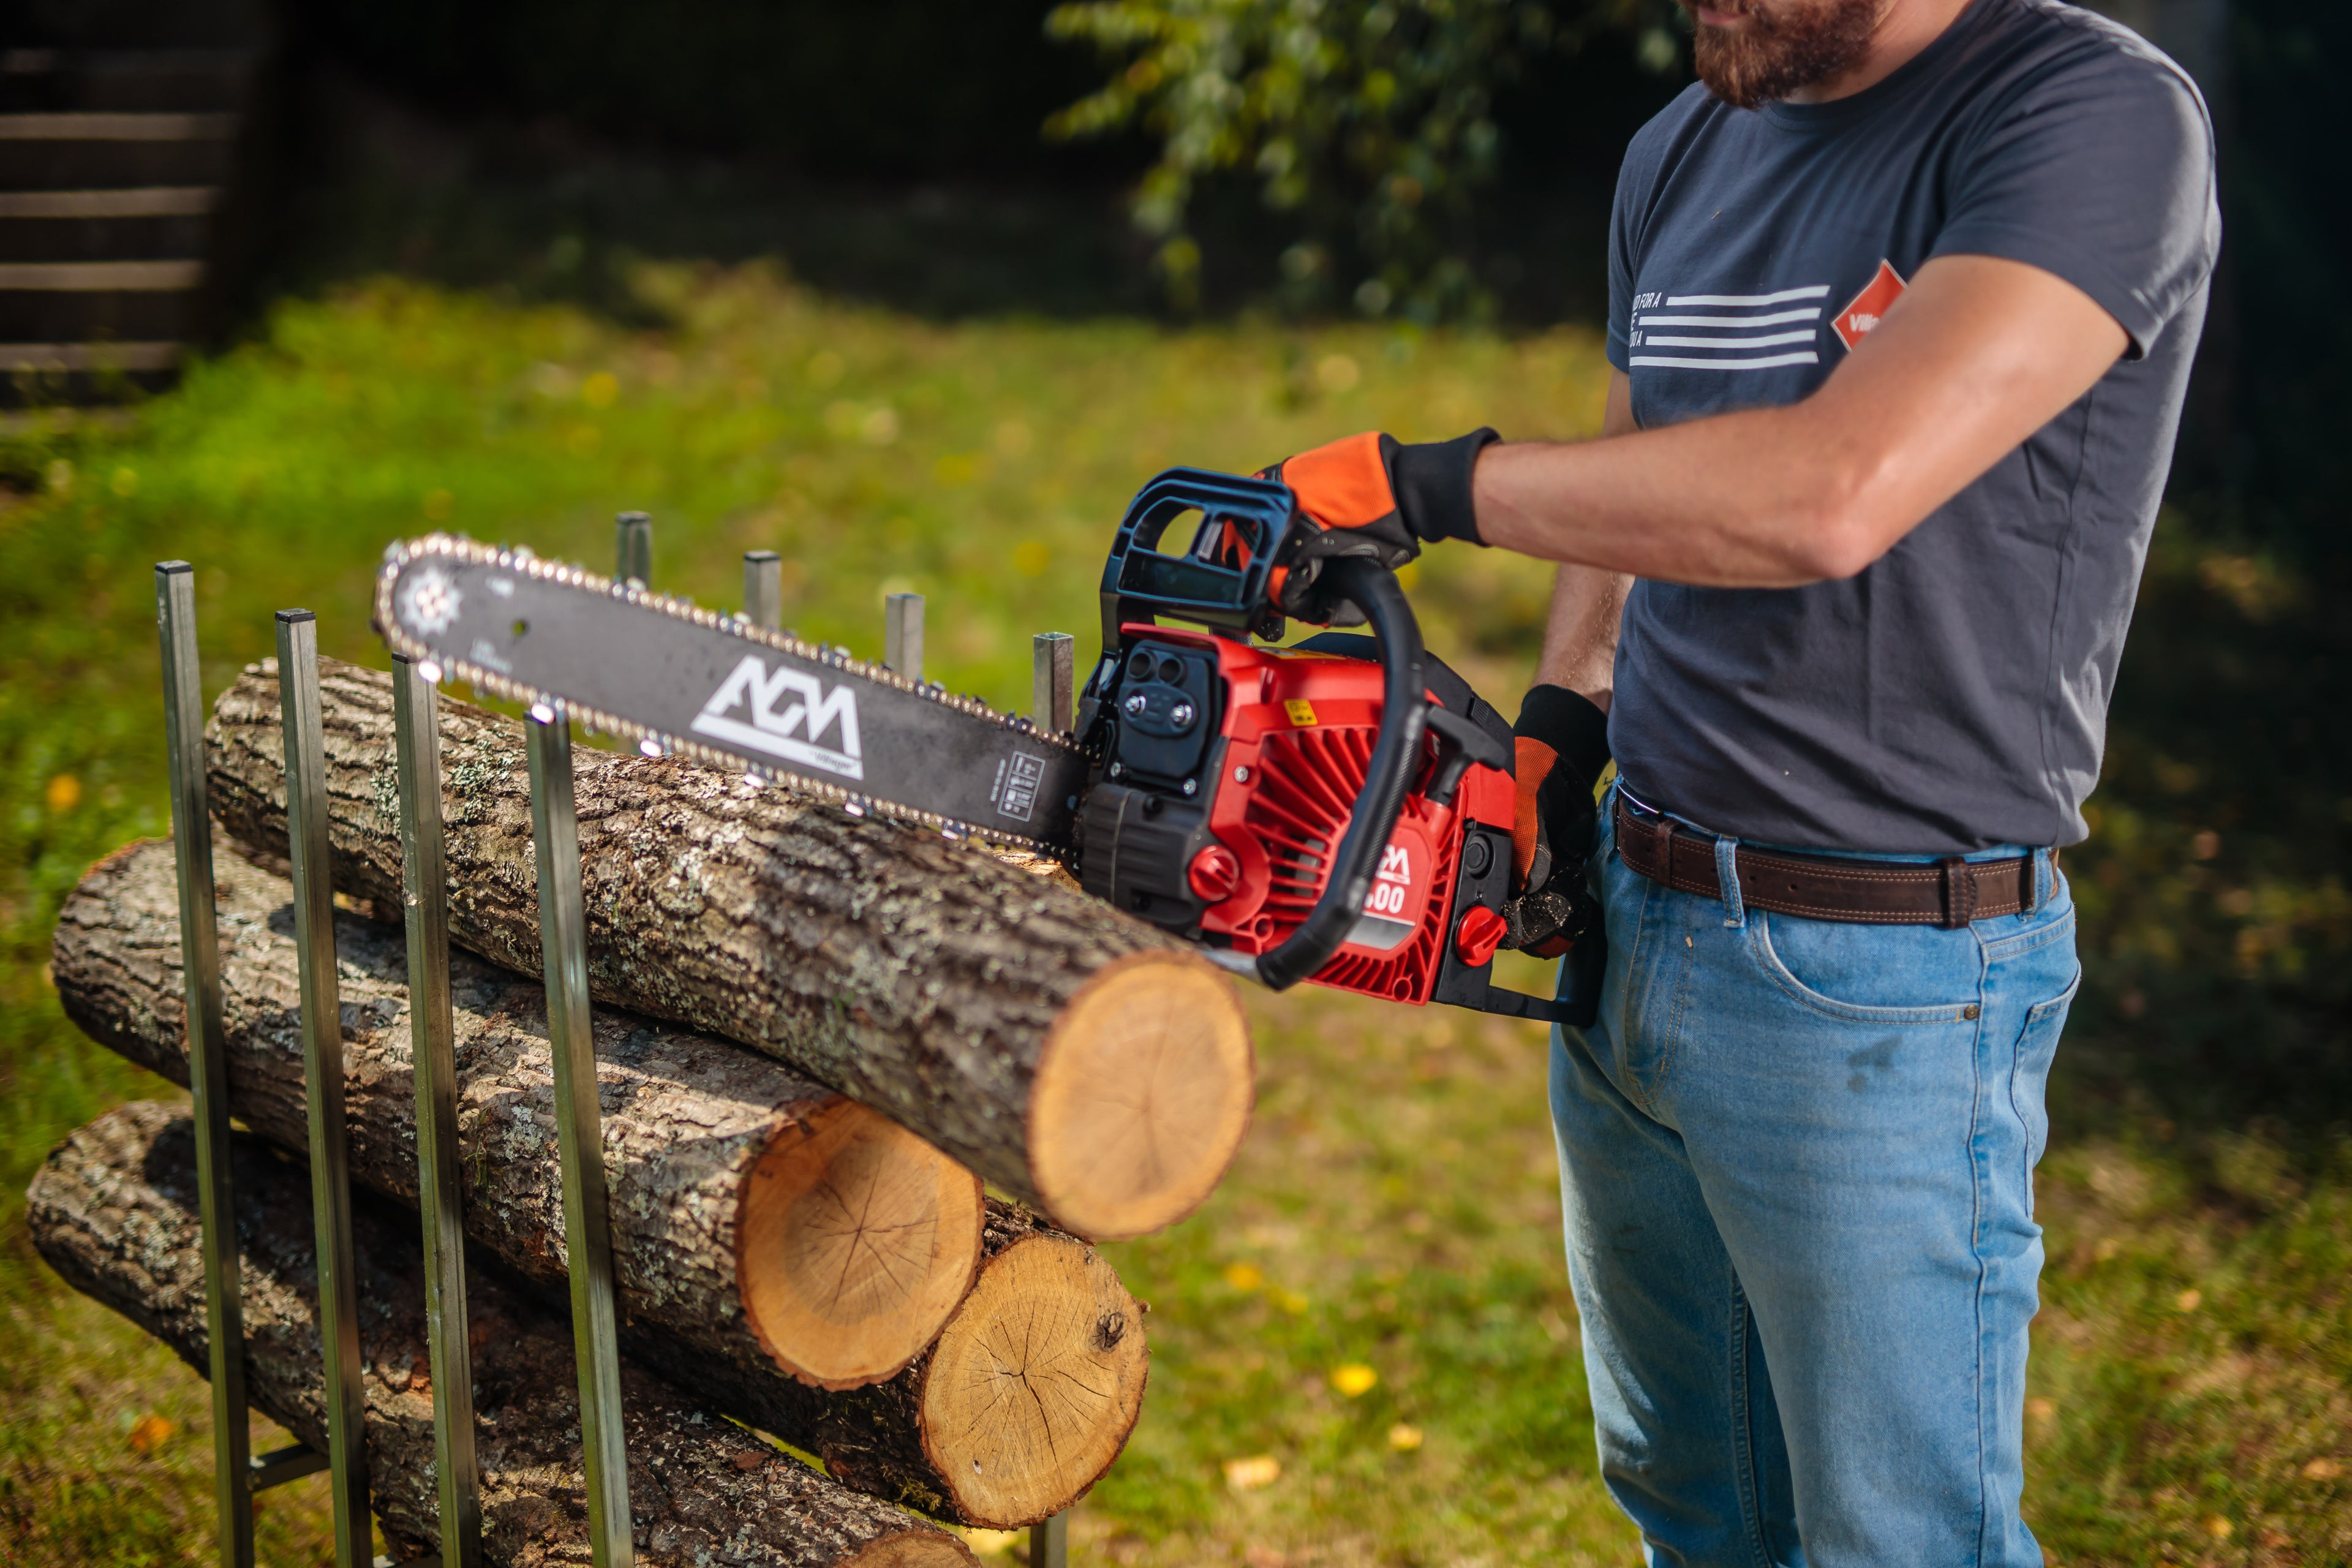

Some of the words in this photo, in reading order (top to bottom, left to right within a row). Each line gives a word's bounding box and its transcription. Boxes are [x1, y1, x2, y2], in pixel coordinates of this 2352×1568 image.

[1638, 292, 1655, 309] FOR
[1652, 292, 1662, 308] A
[1636, 330, 1643, 346] A
[703, 654, 862, 760] AGM
